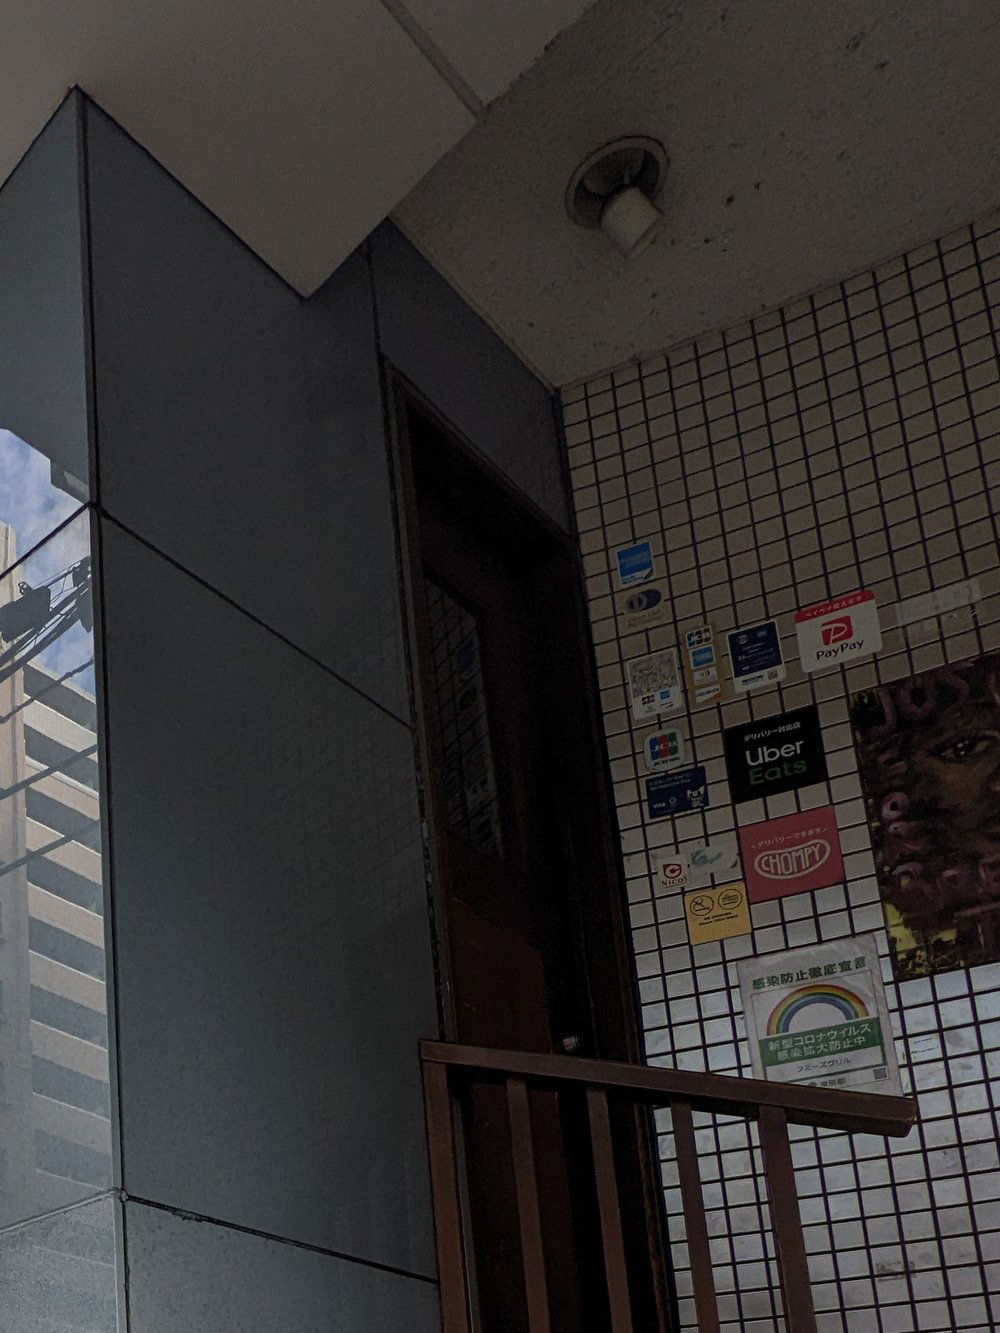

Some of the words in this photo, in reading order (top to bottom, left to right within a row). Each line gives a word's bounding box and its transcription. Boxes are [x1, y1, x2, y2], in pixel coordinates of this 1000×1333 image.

[816, 639, 864, 660] PayPay
[745, 740, 804, 766] Uber
[748, 759, 808, 786] Eats
[760, 843, 821, 876] CHOMPY
[751, 956, 866, 991] 感染防止徹底宣言
[768, 1022, 872, 1051] 新型コロナウイルス
[776, 1034, 866, 1061] 感染拡大防止中
